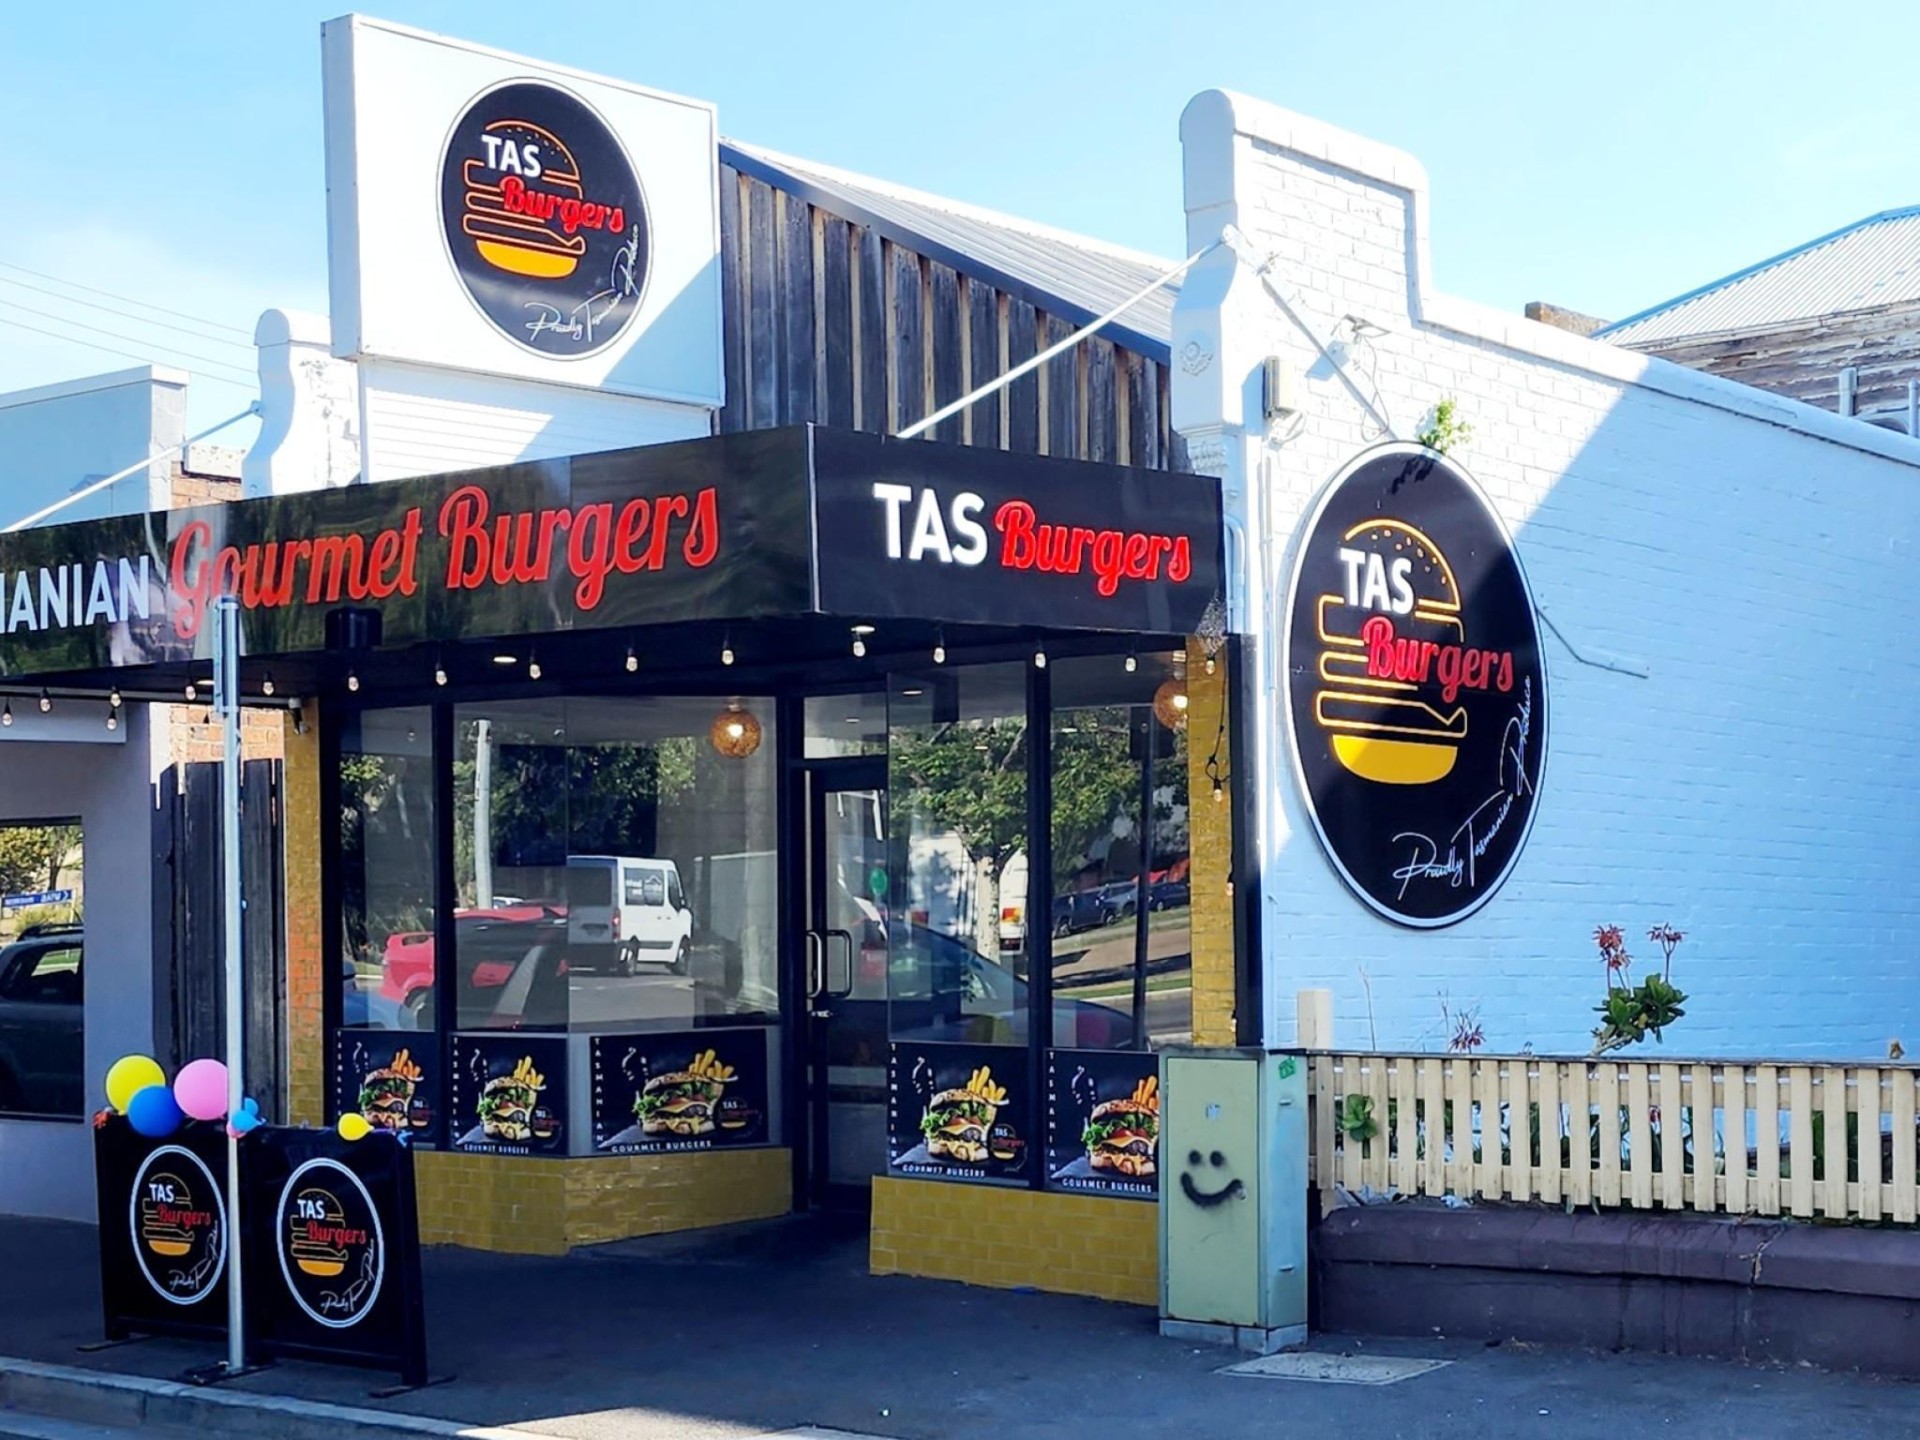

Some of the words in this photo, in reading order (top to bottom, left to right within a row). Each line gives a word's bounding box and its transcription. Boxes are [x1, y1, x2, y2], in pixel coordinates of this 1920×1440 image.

[480, 134, 542, 178] TAS
[500, 175, 624, 234] Burgers
[873, 482, 987, 566] TAS
[994, 500, 1192, 597] Burgers
[169, 507, 425, 639] Gourmet
[438, 485, 720, 611] Burgers
[1340, 547, 1414, 615] TAS
[1361, 615, 1514, 704] Burgers
[594, 1037, 604, 1142] TASMANIAN
[611, 1144, 661, 1153] GOURMET
[666, 1140, 712, 1150] BURGERS
[149, 1183, 175, 1203] TAS
[1062, 1178, 1107, 1190] GOURMET
[1111, 1181, 1152, 1193] BURGERS
[157, 1204, 211, 1230] Burgers
[297, 1200, 325, 1219] TAS
[306, 1221, 366, 1249] Burgers
